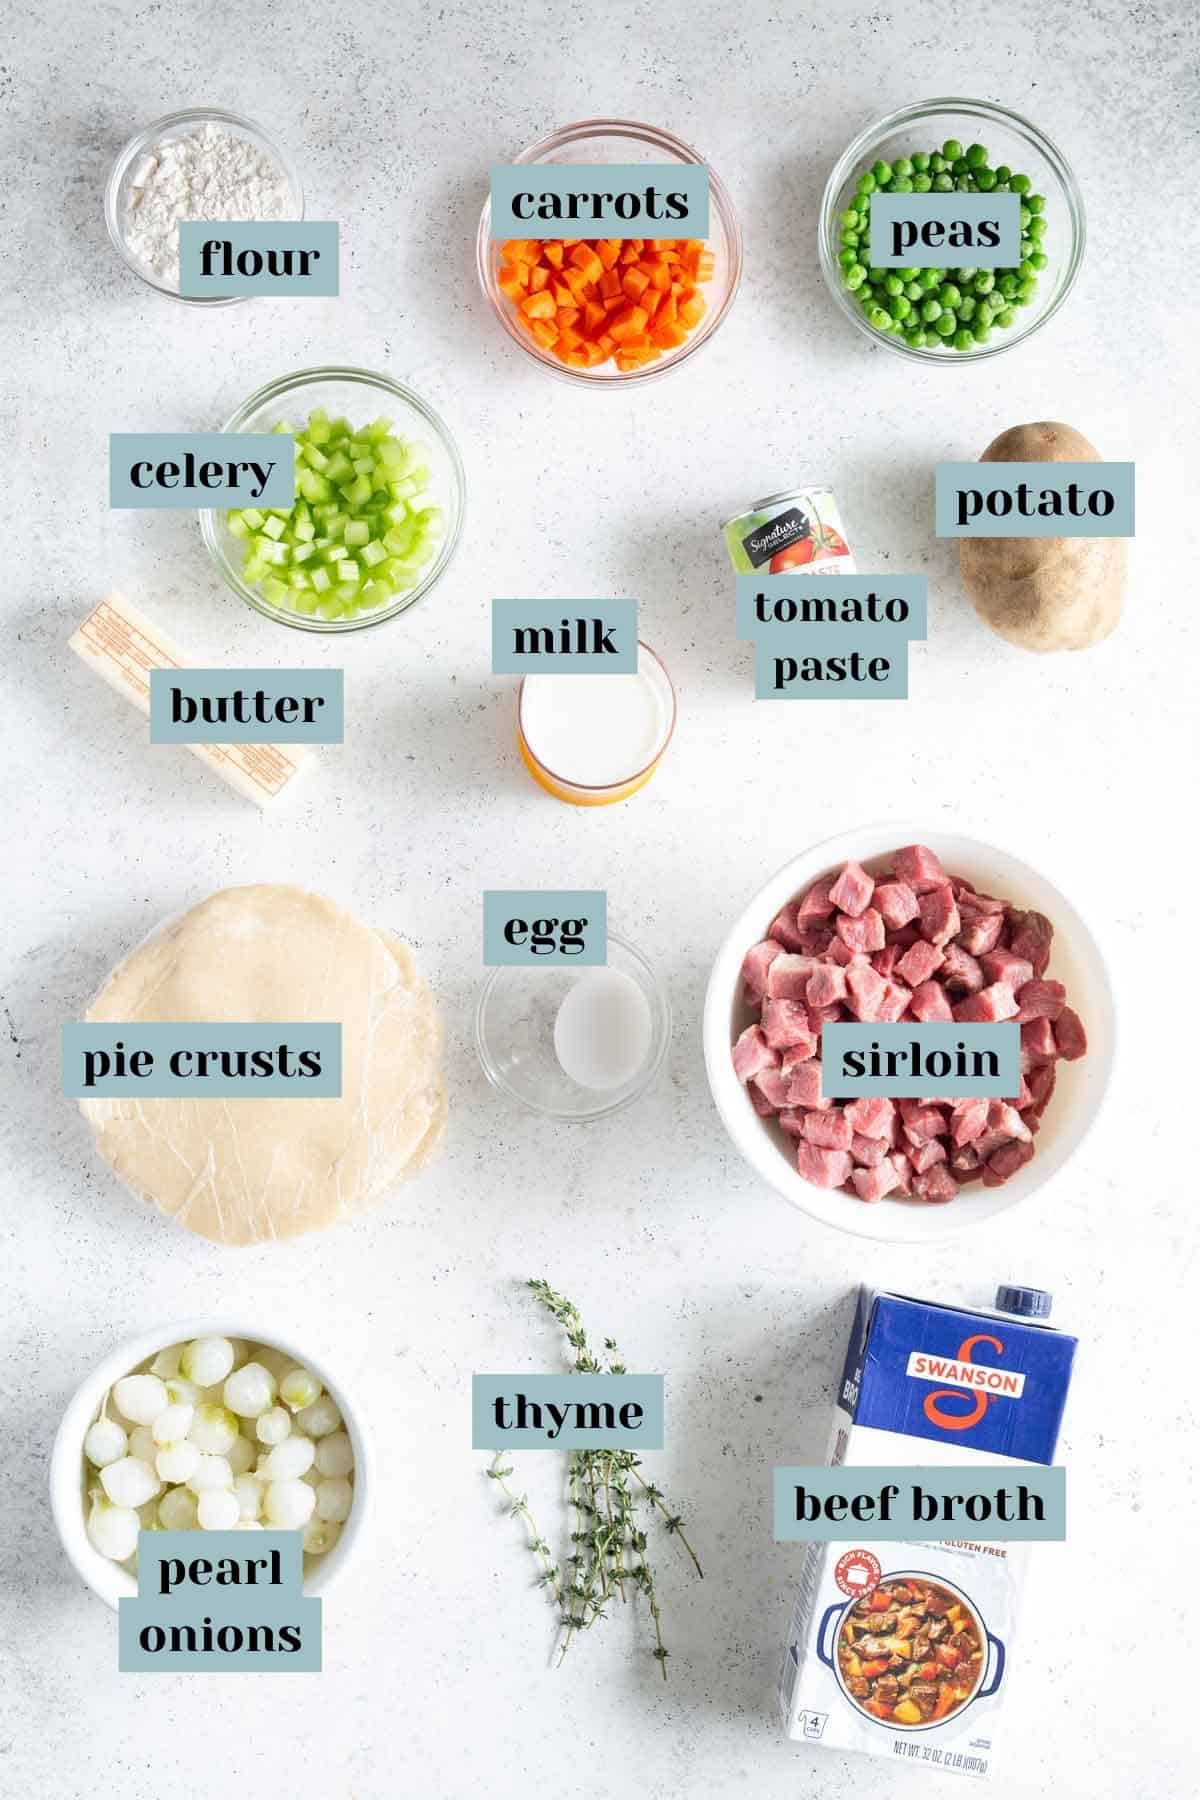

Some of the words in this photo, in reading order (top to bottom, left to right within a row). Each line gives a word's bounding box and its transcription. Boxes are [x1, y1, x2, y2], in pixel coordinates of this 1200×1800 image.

[751, 519, 799, 553] Signature
[915, 1357, 1018, 1393] SWANSON
[983, 1546, 1007, 1559] FREE
[810, 1716, 819, 1727] 4
[893, 1739, 907, 1756] NET
[922, 1746, 932, 1761] 32
